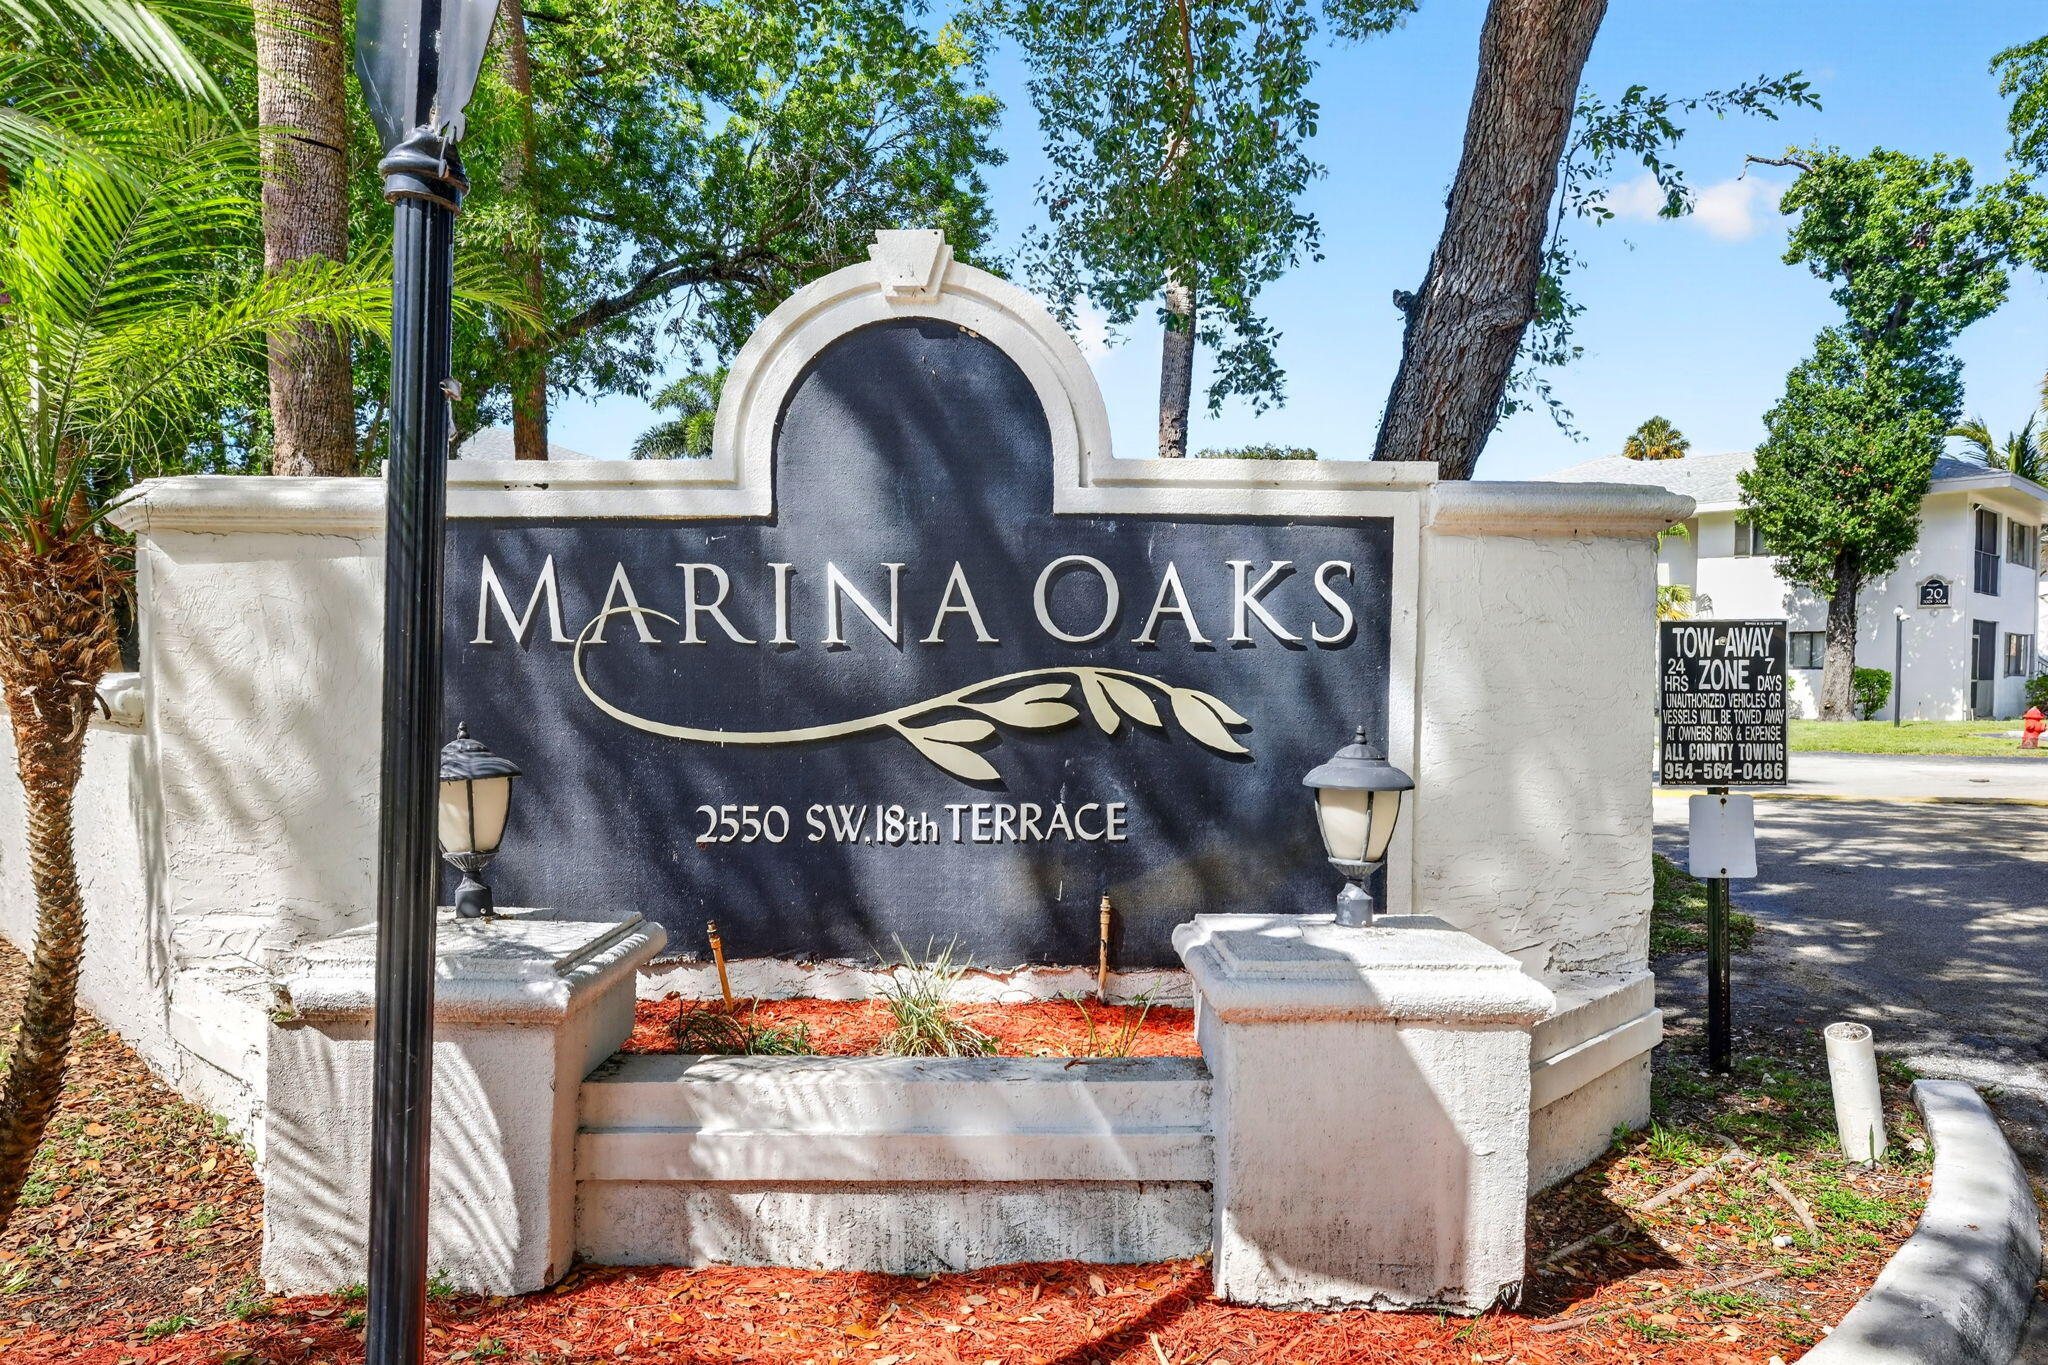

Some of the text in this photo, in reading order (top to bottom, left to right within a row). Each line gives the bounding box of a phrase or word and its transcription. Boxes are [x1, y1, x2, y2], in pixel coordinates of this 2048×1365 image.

[469, 553, 1355, 645] MARINA OAKS
[1926, 588, 1943, 599] 20
[1668, 658, 1685, 674] 24
[1765, 658, 1775, 674] 7
[1699, 659, 1749, 690] ZONE
[1665, 676, 1688, 691] HRS
[1758, 675, 1782, 691] DAYS
[1666, 693, 1780, 708] UNAUTHORIZED VEHICLES OR
[1663, 709, 1784, 725] VESSELS WILL BE TOWED AWAY
[1667, 726, 1781, 741] AT OWNERS RISK & EXPENSE
[1665, 743, 1783, 761] ALL COUNTY TOWING
[1665, 763, 1783, 780] 954-564-0486
[696, 804, 790, 844] 2550
[945, 801, 1128, 842] TERRACE
